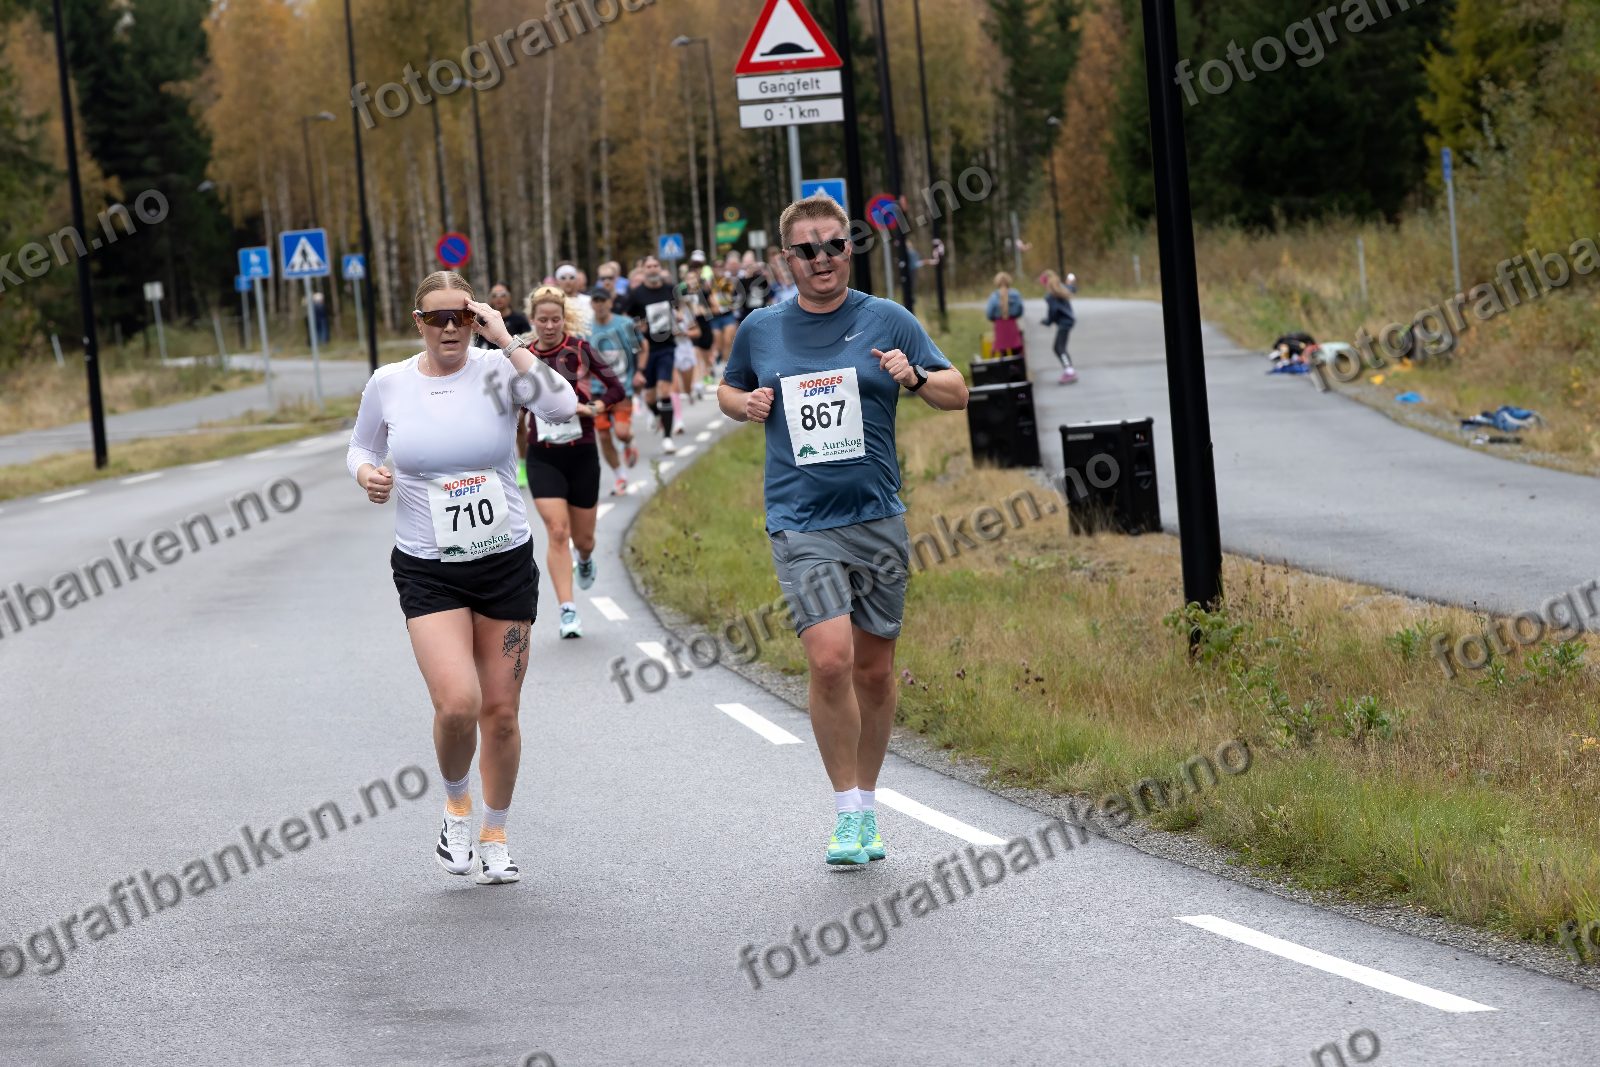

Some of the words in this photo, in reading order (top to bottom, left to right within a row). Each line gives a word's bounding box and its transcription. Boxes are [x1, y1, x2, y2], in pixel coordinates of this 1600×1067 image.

[758, 77, 822, 95] Gangfelt
[799, 106, 820, 119] km
[798, 375, 843, 390] NORGES
[803, 384, 837, 398] LØPET
[800, 399, 846, 432] 867
[821, 437, 862, 451] Aurskog
[442, 475, 487, 491] NORGES
[449, 484, 482, 499] LØPET
[445, 498, 494, 532] 710
[469, 533, 510, 551] Aurskog
